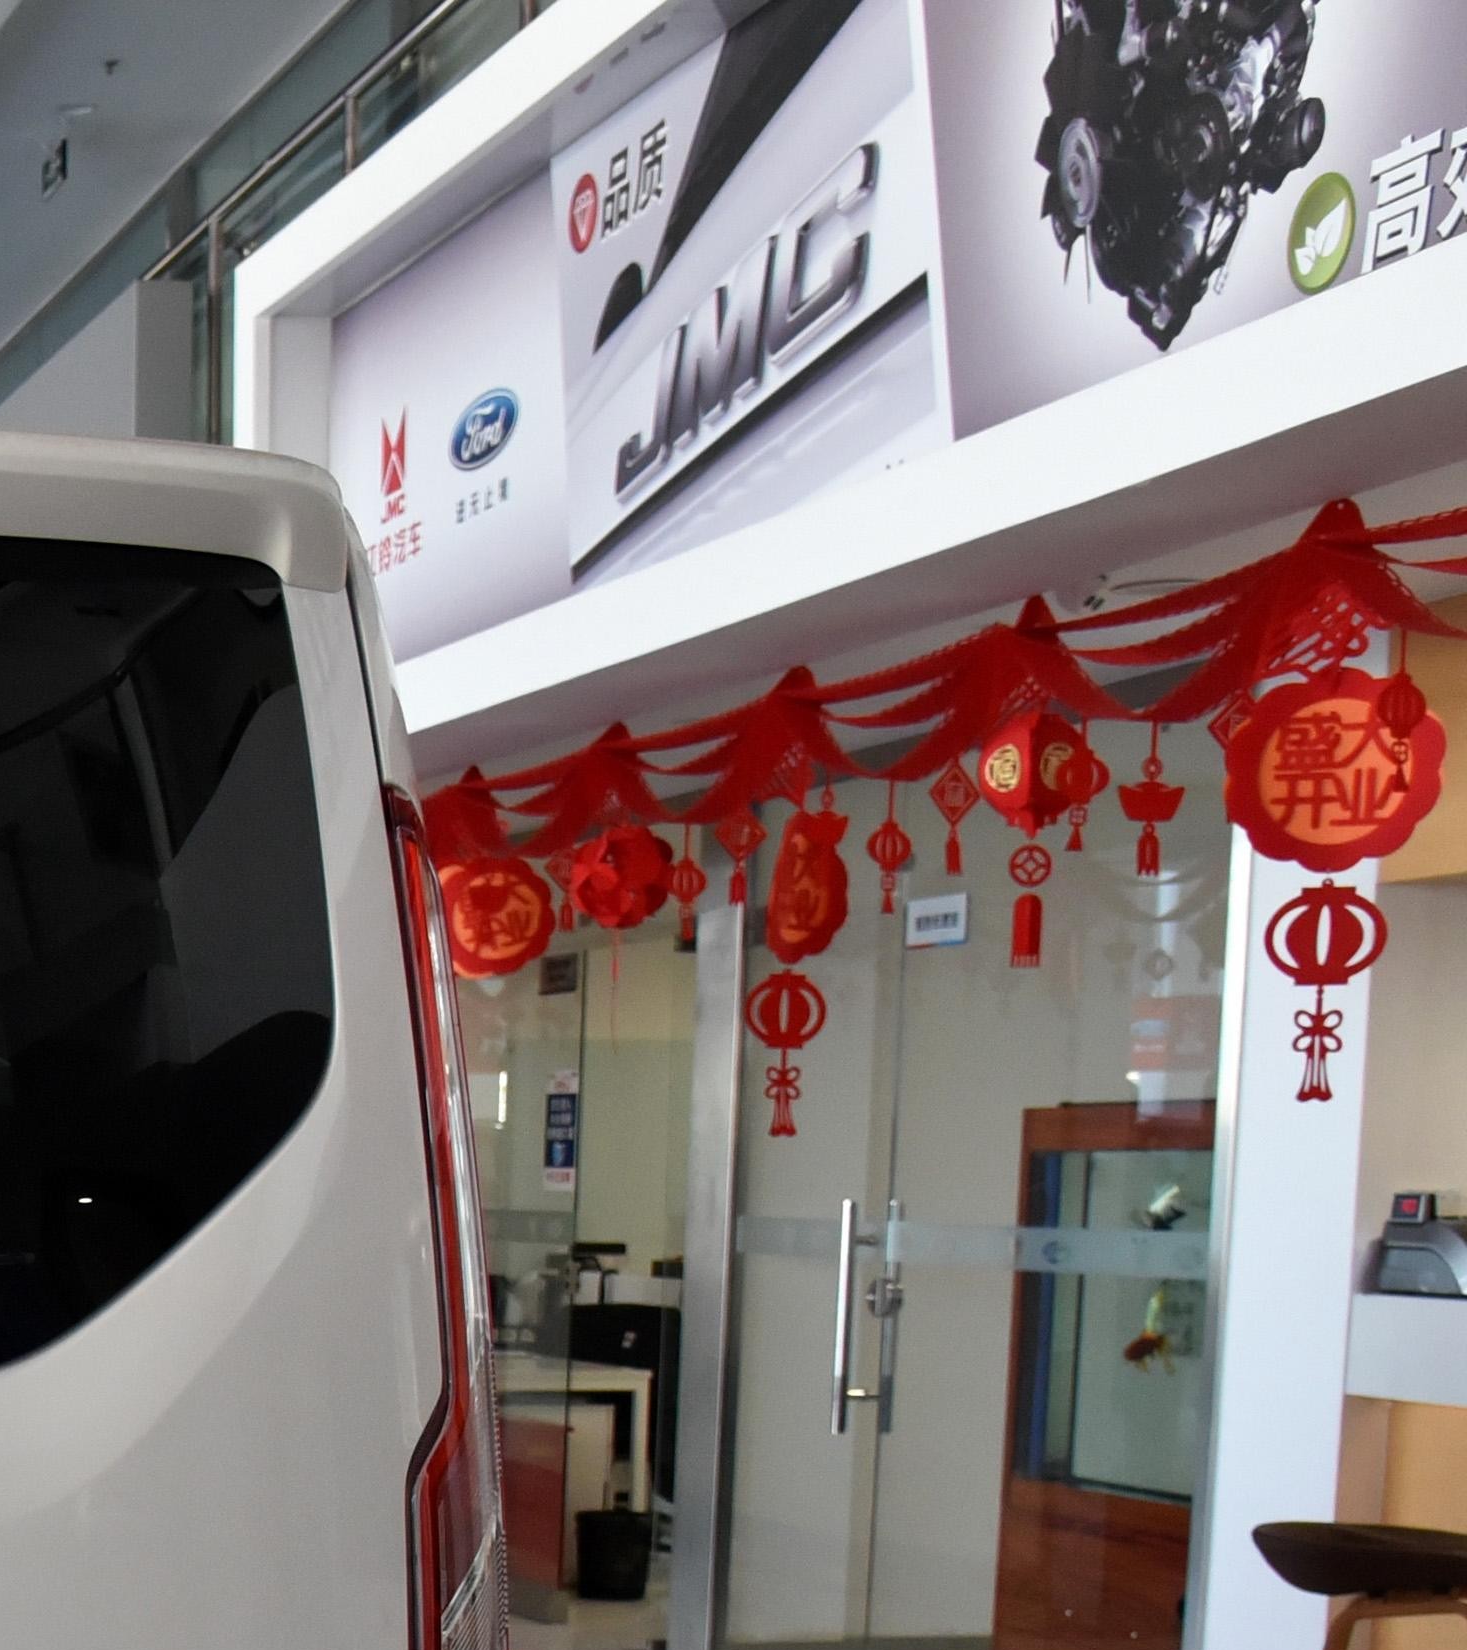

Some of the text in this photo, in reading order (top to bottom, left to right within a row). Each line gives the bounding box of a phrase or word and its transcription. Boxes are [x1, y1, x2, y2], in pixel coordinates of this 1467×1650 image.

[601, 118, 667, 239] 品质
[615, 140, 879, 502] JMC
[380, 493, 406, 525] JMC
[1274, 705, 1409, 771] 盛大
[1271, 767, 1399, 830] 开业
